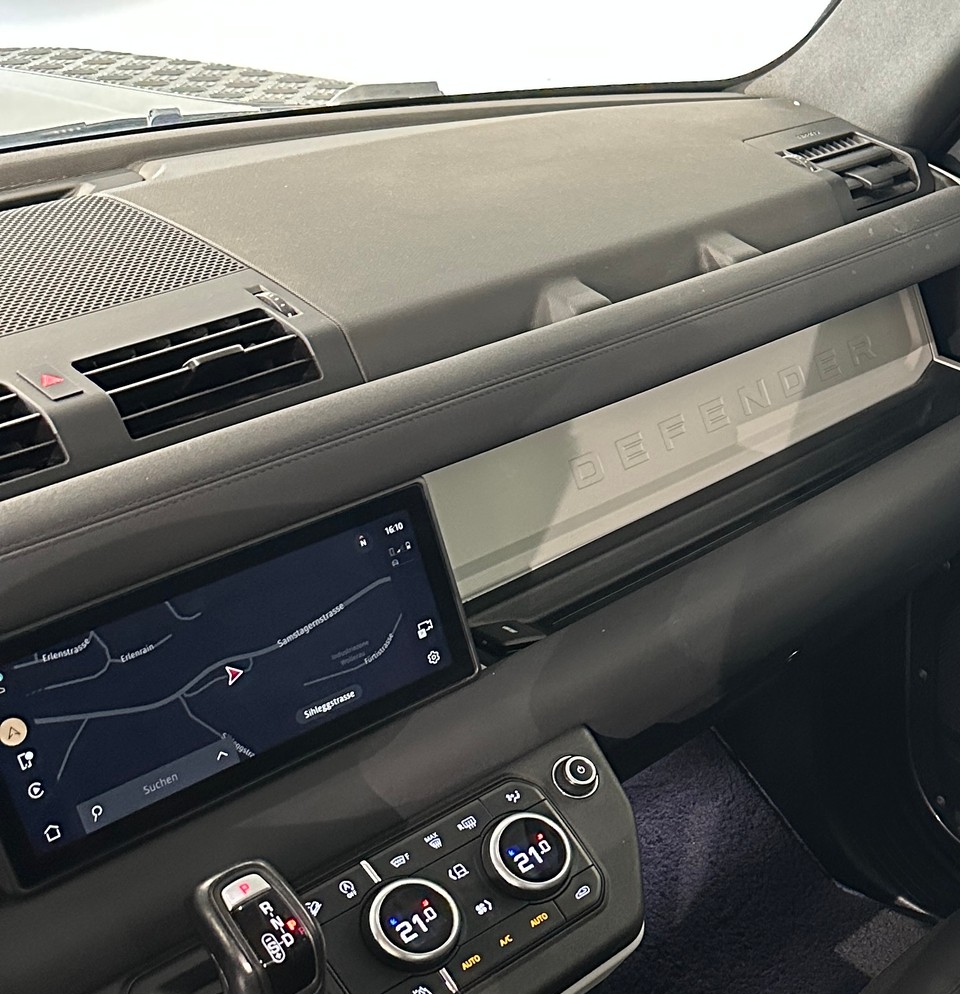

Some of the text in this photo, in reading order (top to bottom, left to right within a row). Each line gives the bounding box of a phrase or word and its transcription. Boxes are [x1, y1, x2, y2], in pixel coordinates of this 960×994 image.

[568, 334, 877, 490] DEFENDER
[384, 521, 404, 535] 16:10
[277, 603, 345, 647] Samstagernstrasse
[42, 638, 90, 662] Erlenstrasse
[120, 643, 155, 663] Erlenrain
[303, 691, 355, 719] Sihleggstrasse
[143, 773, 178, 795] Suchen
[423, 832, 439, 843] MAX
[404, 852, 410, 861] F
[513, 839, 552, 874] 21.0
[239, 883, 250, 894] P
[259, 901, 295, 947] R N D
[395, 906, 438, 944] 21.0
[529, 912, 549, 928] AUTO
[499, 934, 513, 947] A/C
[461, 954, 481, 971] AUTO
